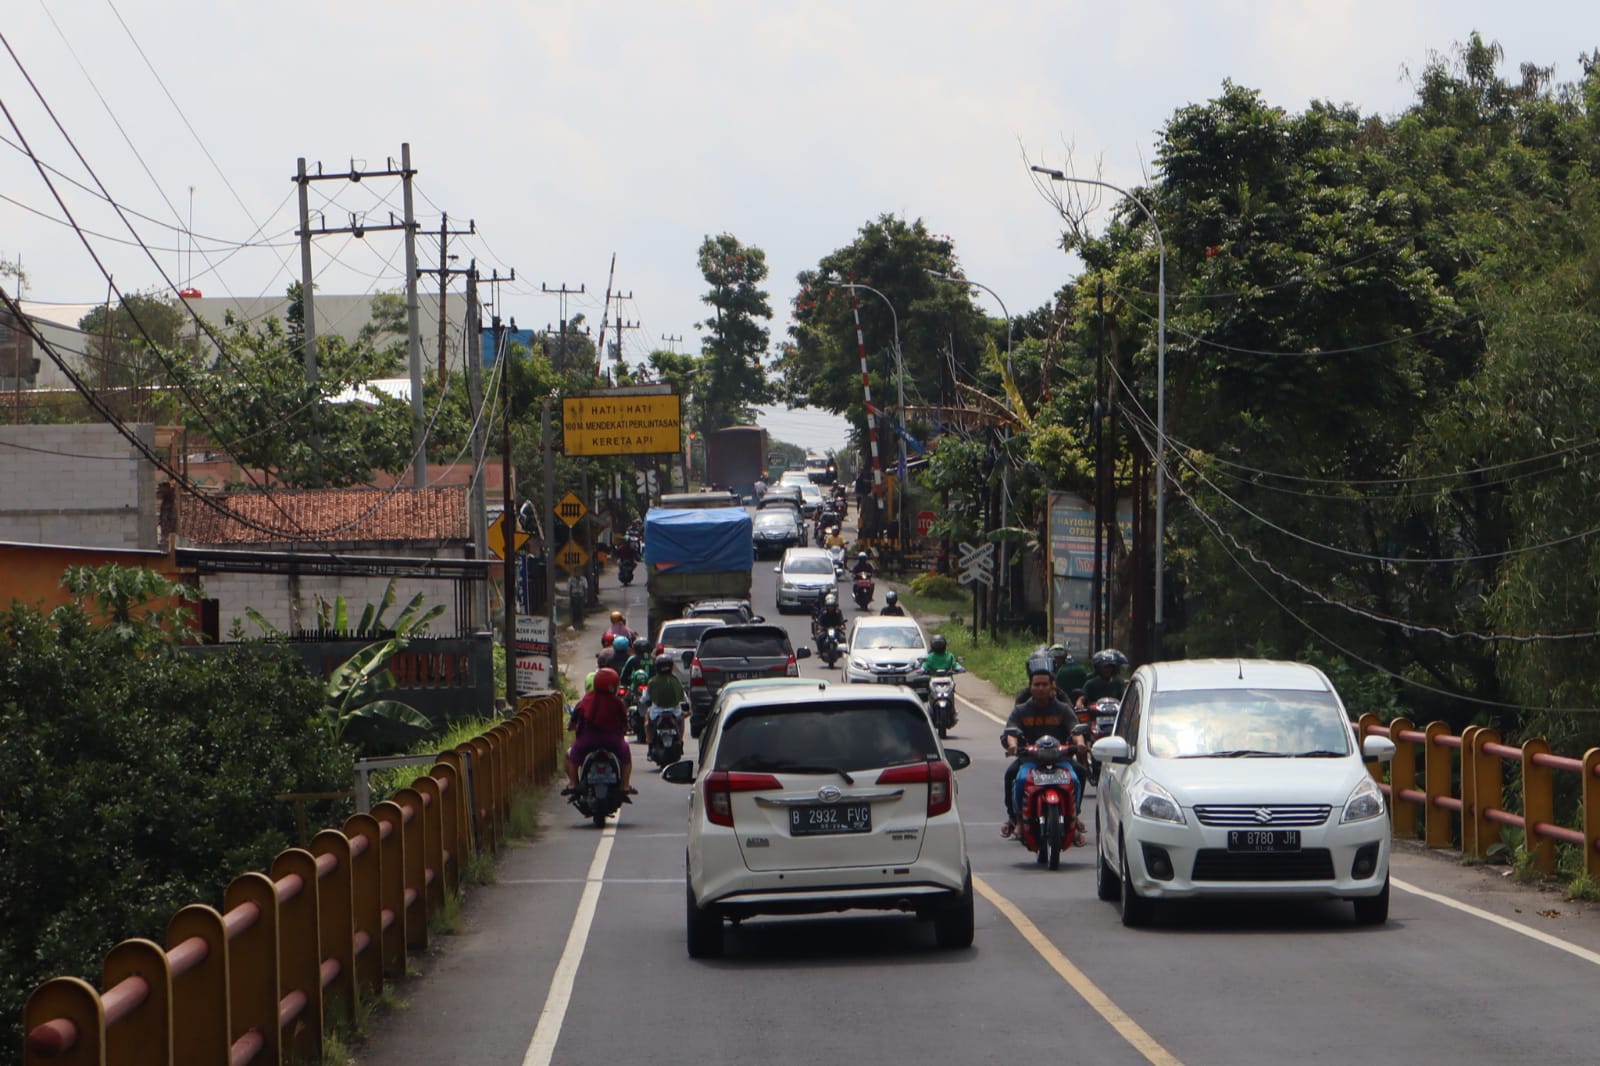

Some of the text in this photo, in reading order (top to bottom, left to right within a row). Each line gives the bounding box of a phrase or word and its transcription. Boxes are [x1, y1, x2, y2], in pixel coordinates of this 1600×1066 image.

[591, 405, 616, 415] HATI
[627, 403, 652, 414] HATI
[586, 420, 628, 431] MENDEKATI
[629, 418, 678, 430] PERLINTASAN
[592, 435, 653, 447] KERETA API
[515, 660, 545, 671] JUAL
[792, 806, 869, 825] B 2932 FVG
[1247, 831, 1274, 845] 8780
[1282, 831, 1296, 845] JH
